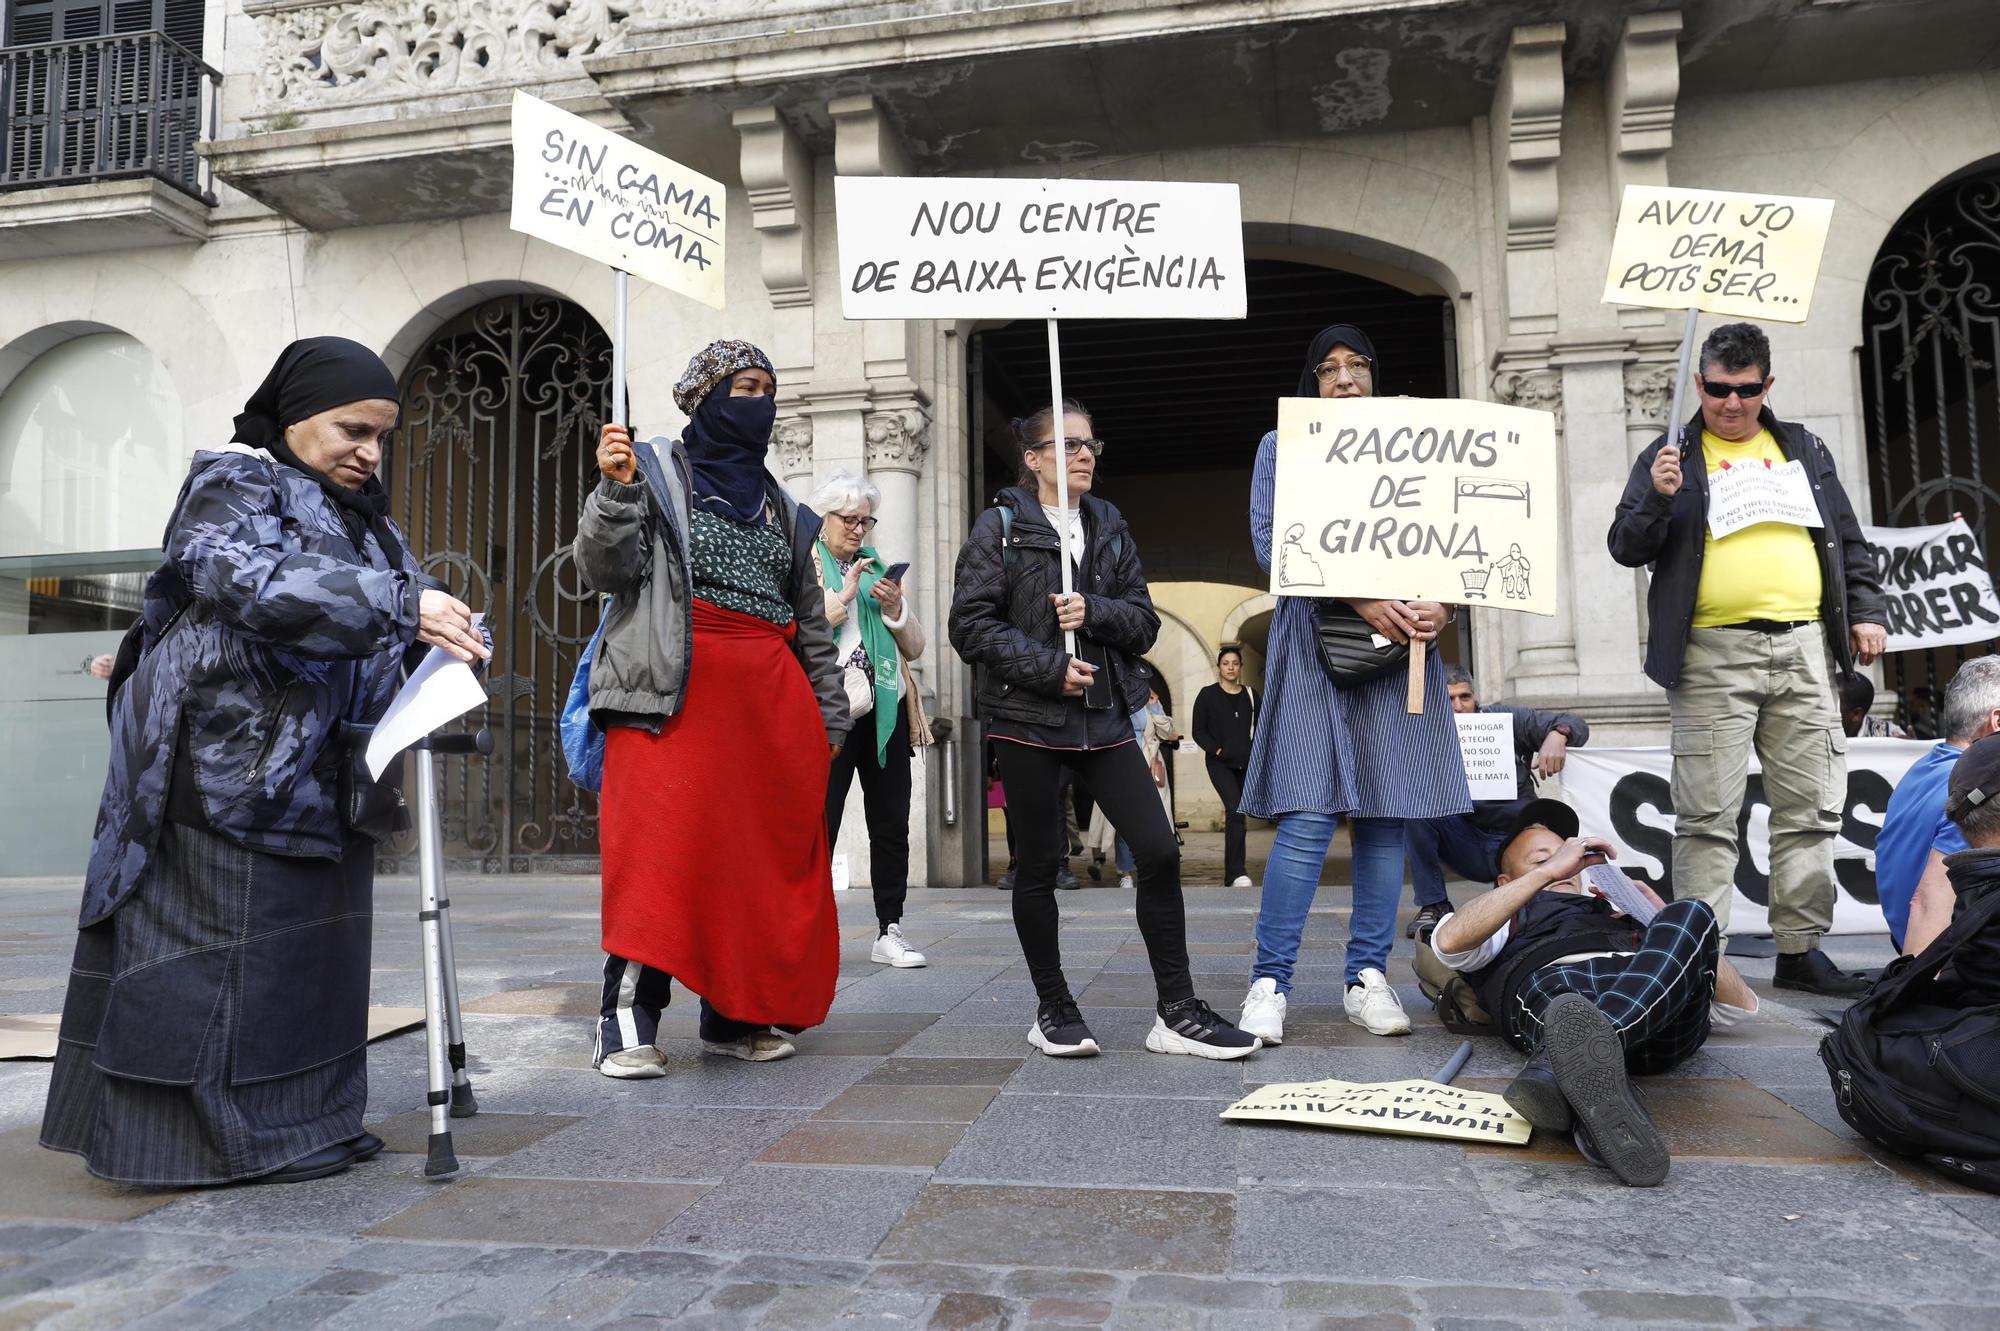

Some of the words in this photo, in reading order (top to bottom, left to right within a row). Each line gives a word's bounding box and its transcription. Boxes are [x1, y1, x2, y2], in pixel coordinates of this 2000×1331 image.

[542, 129, 608, 175] SIN
[617, 164, 721, 229] CAMA
[539, 188, 593, 226] EN
[611, 211, 712, 271] COMA
[911, 200, 1001, 236] NOU
[1020, 198, 1161, 237] CENTRE
[1638, 200, 1726, 225] AVUI
[1740, 203, 1794, 231] JO
[851, 260, 900, 293] DE
[910, 259, 1027, 294] BAIXA
[1036, 244, 1226, 294] EXIGÈNCIA
[1670, 231, 1768, 269] DEMÀ
[1620, 262, 1702, 291] POTS
[1703, 268, 1798, 304] SER...
[1370, 475, 1427, 508] DE
[1726, 507, 1741, 517] NO
[1320, 517, 1489, 564] GIRONA
[1885, 582, 2000, 638] RRER
[1468, 735, 1495, 743] TECHO
[1484, 773, 1510, 781] MATA
